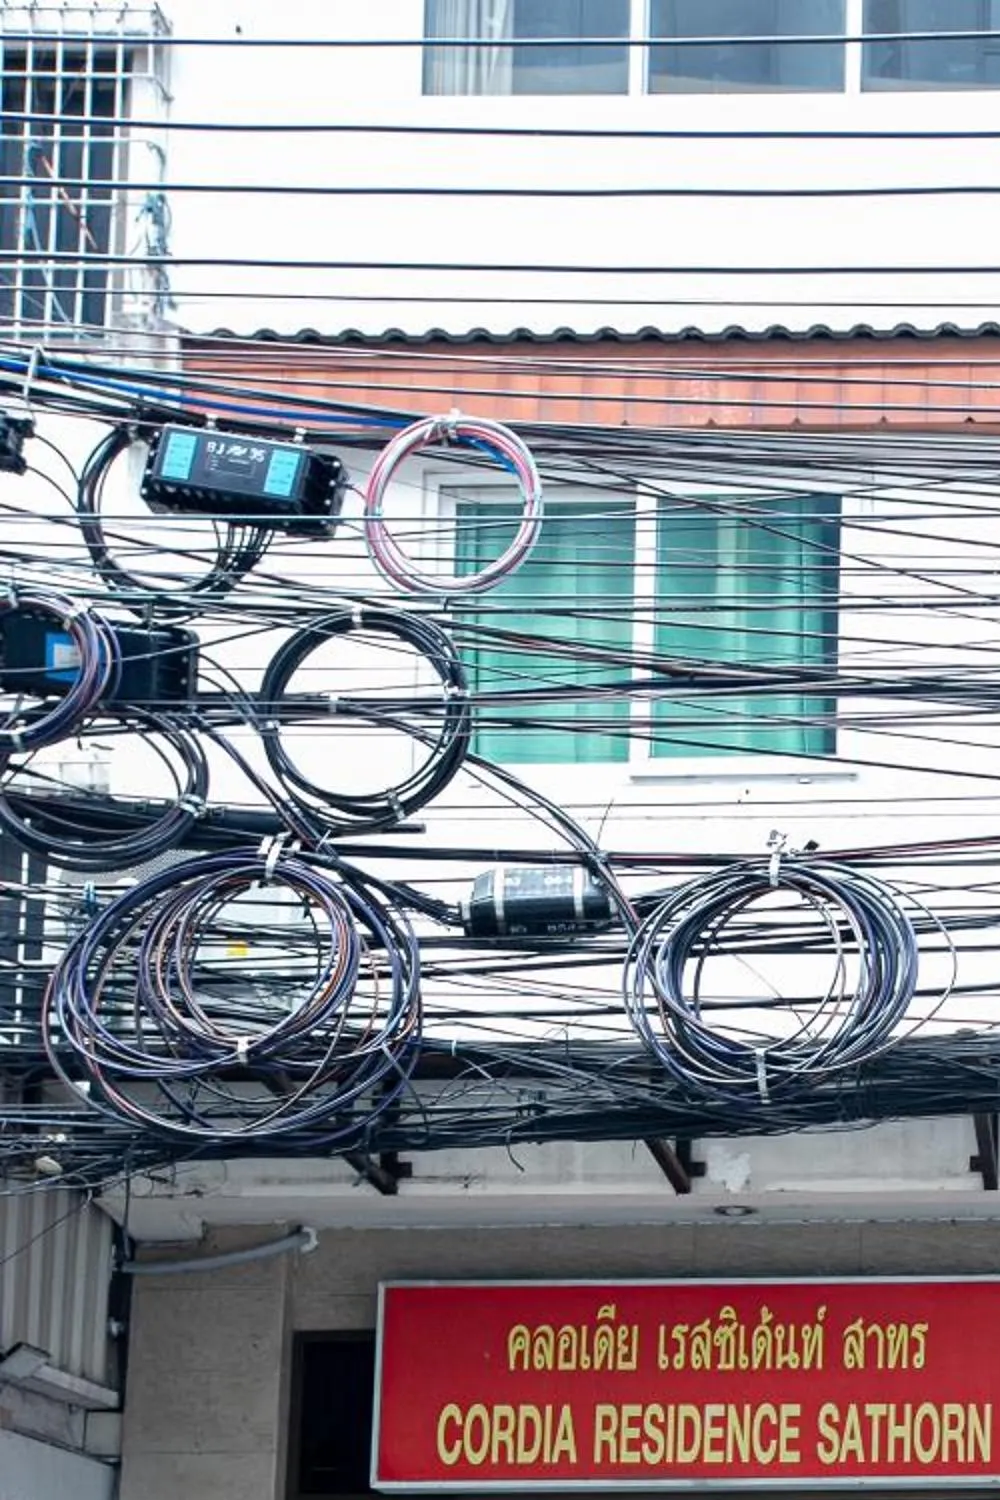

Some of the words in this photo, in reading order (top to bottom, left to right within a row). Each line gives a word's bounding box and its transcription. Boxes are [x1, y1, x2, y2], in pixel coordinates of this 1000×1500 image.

[508, 1304, 639, 1371] คลอเดีย
[658, 1305, 827, 1370] เรสซิเด้นท์
[843, 1317, 929, 1369] สาทร
[437, 1403, 577, 1465] CORDIA
[594, 1402, 802, 1464] RESIDENCE
[817, 1401, 993, 1464] SATHORN
